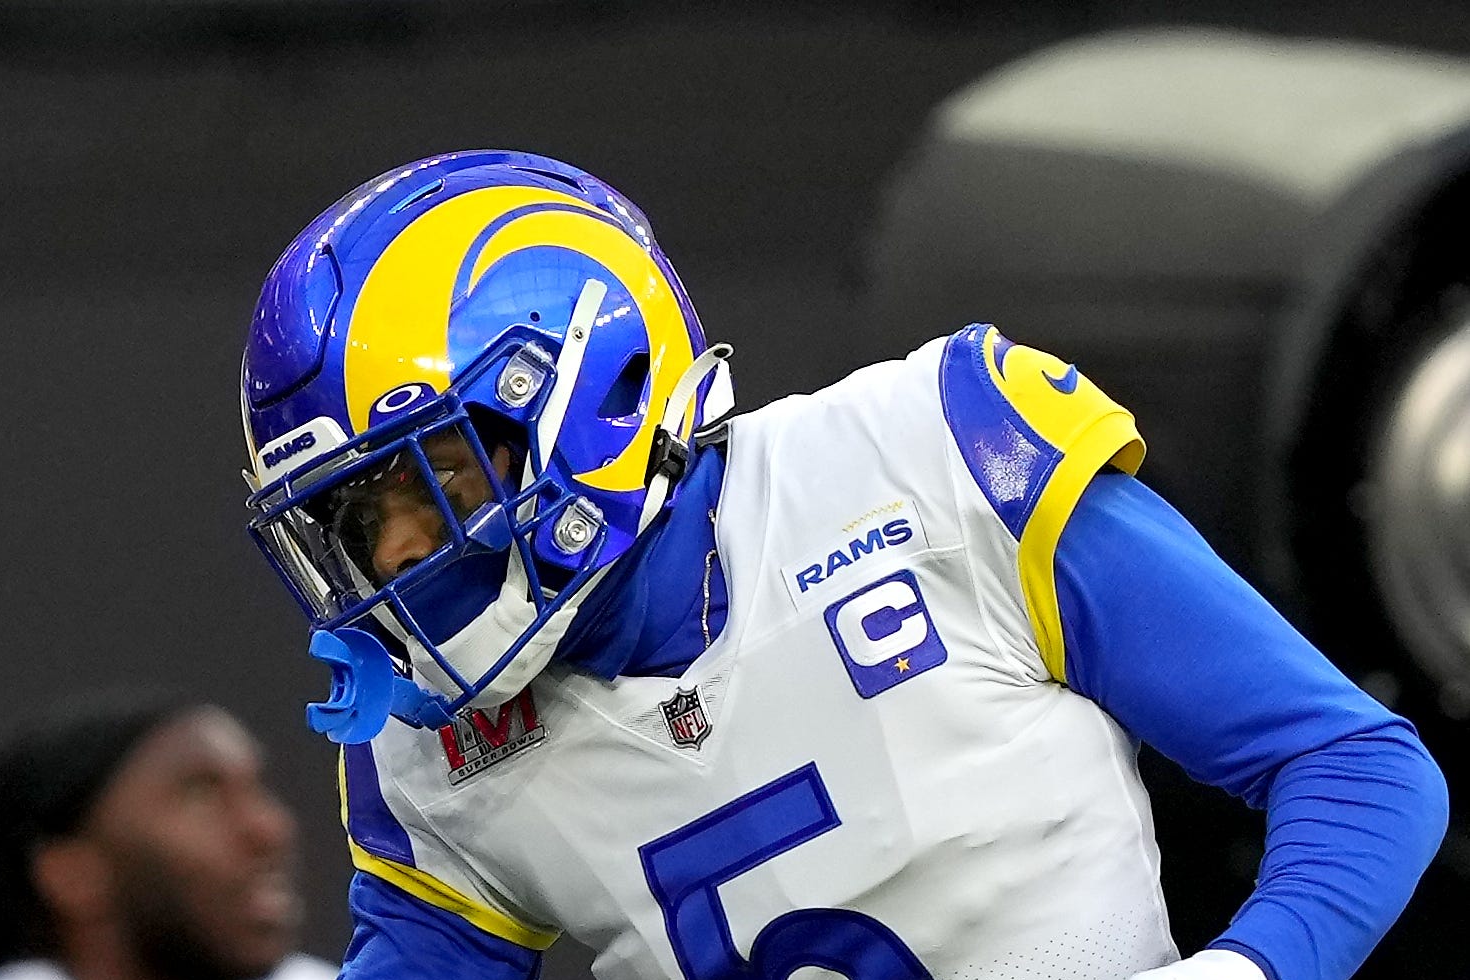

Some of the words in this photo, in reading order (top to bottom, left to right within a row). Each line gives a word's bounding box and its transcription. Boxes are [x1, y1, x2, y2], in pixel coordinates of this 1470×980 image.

[262, 431, 317, 469] RAMS
[795, 518, 913, 594] RAMS
[835, 581, 928, 667] C
[671, 710, 706, 740] NFL
[458, 752, 497, 777] SUPER
[501, 733, 536, 755] BOWL
